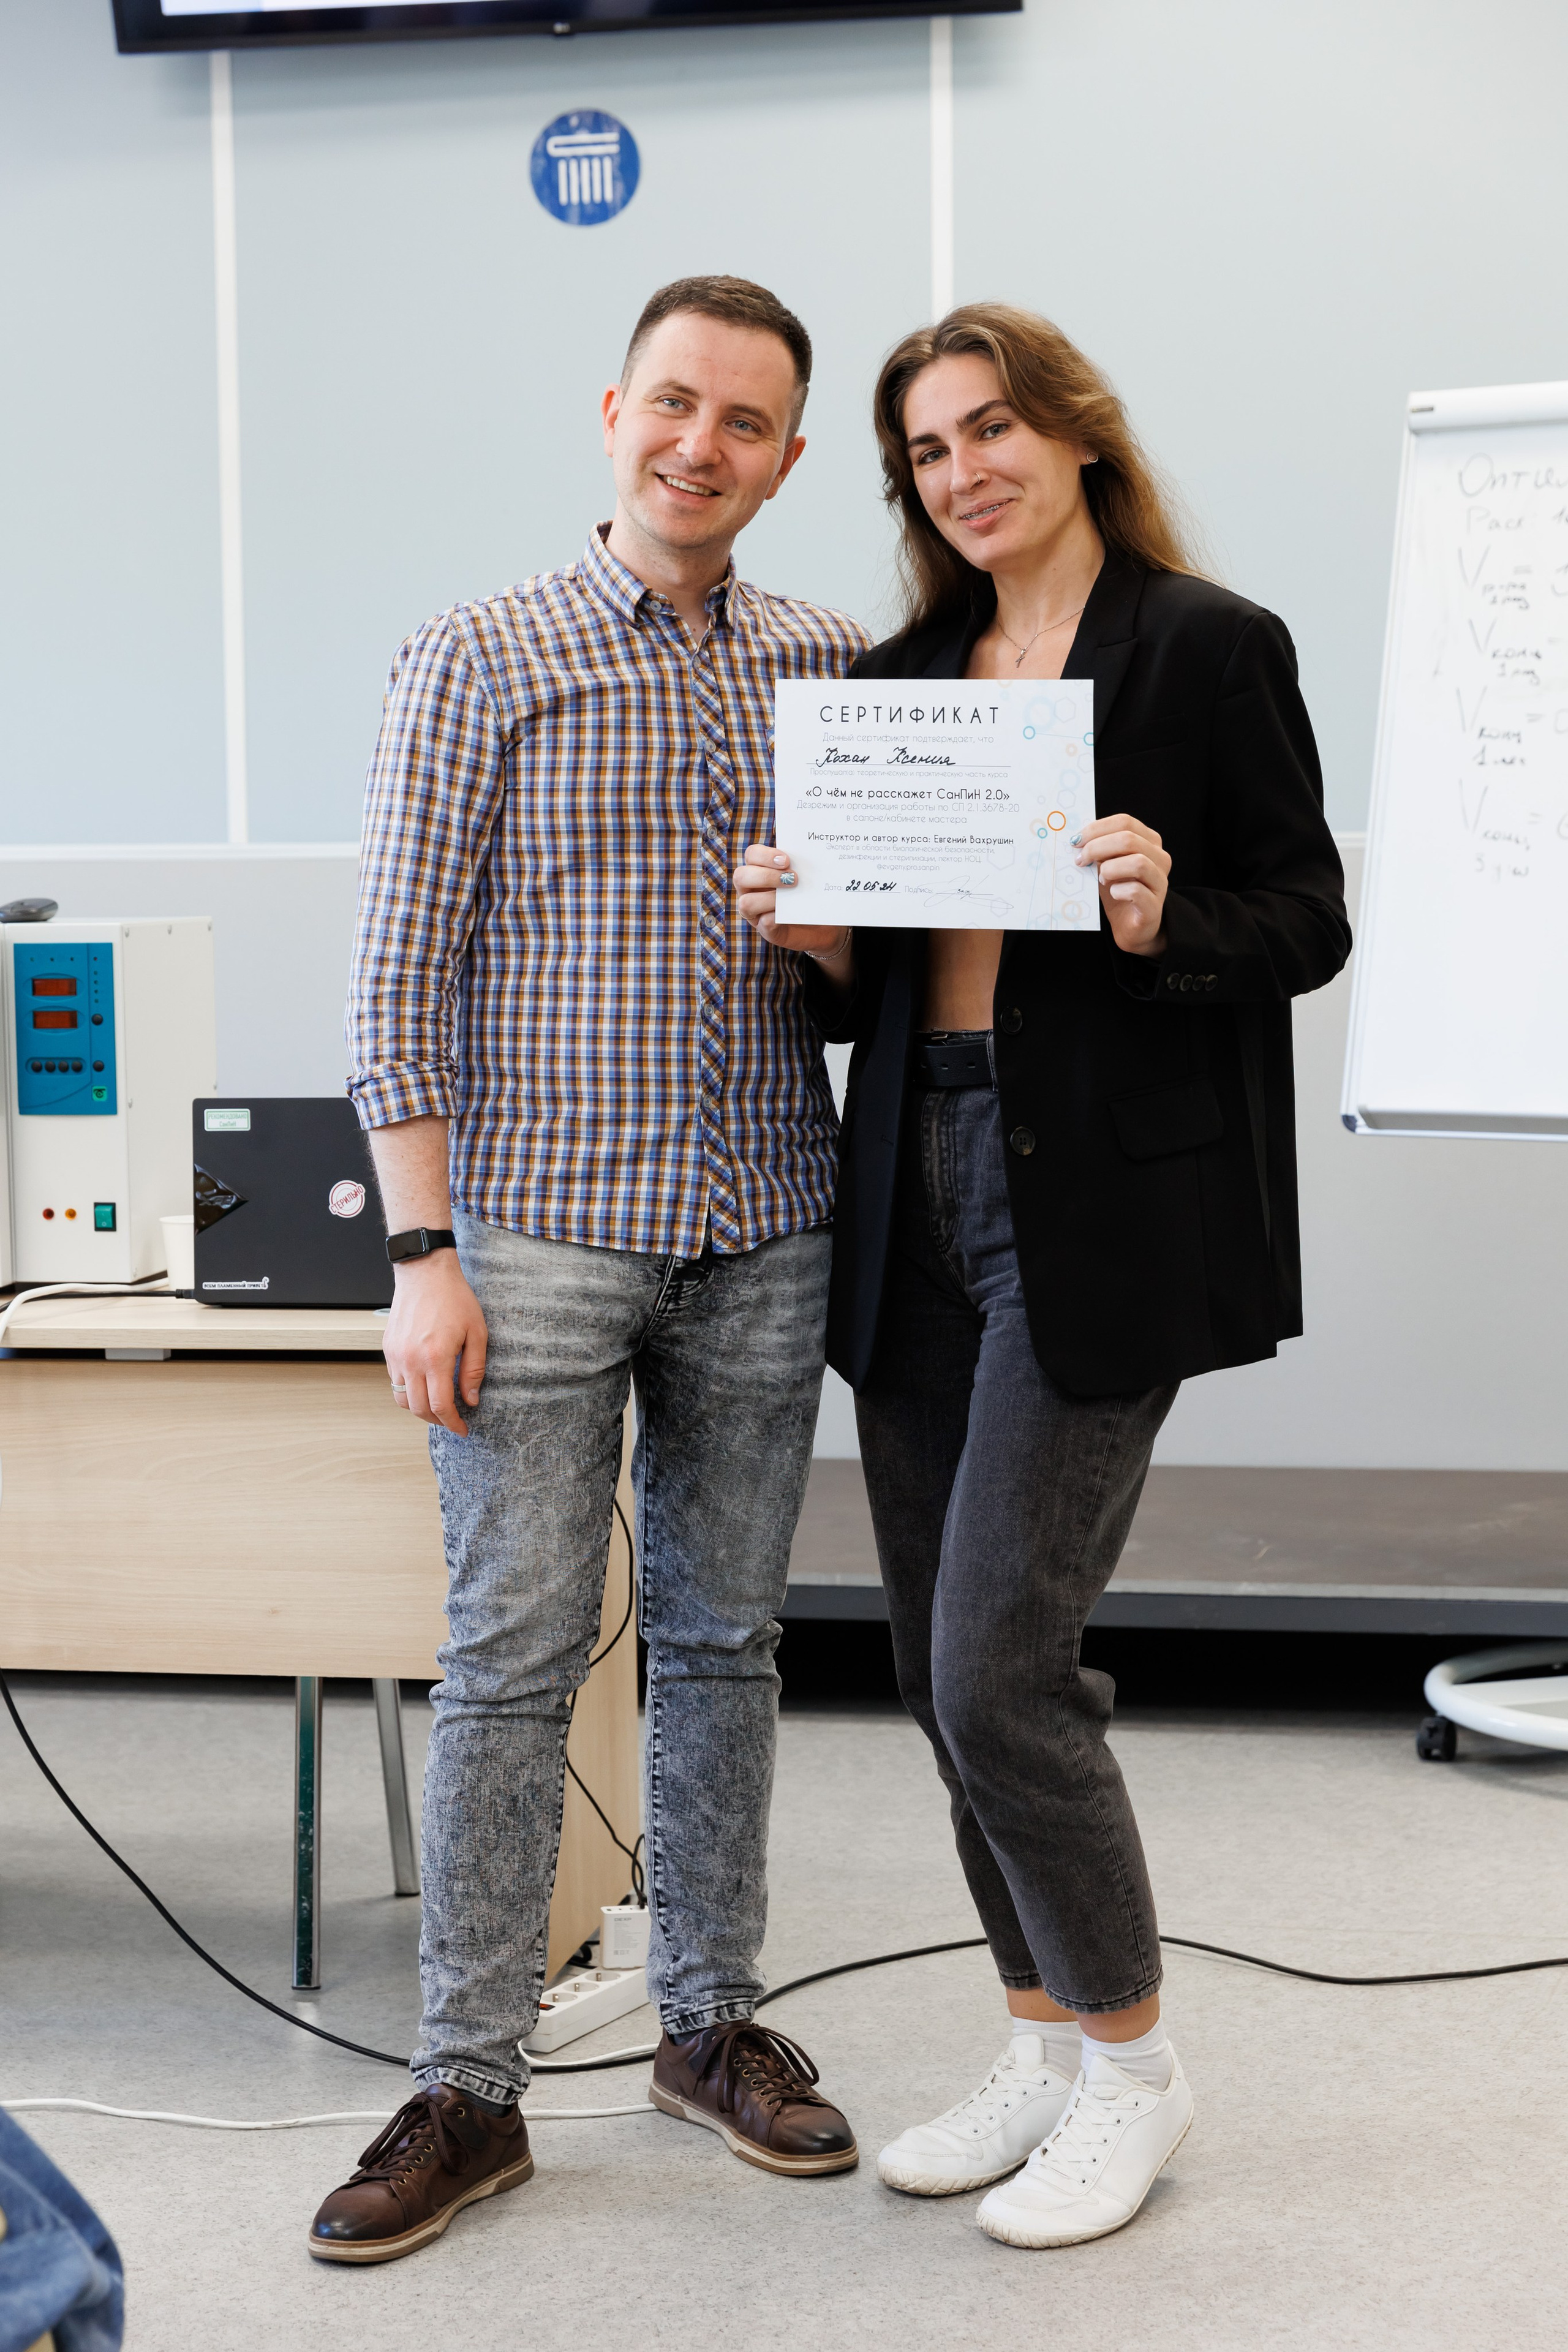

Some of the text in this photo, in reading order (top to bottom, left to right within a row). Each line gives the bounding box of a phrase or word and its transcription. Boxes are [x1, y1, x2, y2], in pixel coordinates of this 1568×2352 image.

[820, 706, 998, 723] СЕРТИФИКАТ
[823, 733, 854, 742] Данный
[857, 734, 910, 743] сертификат
[816, 747, 956, 767] Кохан Ксения
[805, 786, 822, 797] «О
[826, 788, 846, 797] чём
[868, 790, 932, 800] расскажет
[937, 788, 981, 799] СанПиН
[986, 789, 1010, 800] 2.0»
[797, 799, 837, 810] Дезрежим
[846, 802, 898, 811] организация
[901, 802, 935, 812] работы
[952, 802, 965, 812] СП
[967, 803, 1020, 813] 2.1.3678-20
[853, 813, 926, 823] салоне/кабинете
[808, 832, 861, 842] Инструктор
[934, 835, 967, 843] Евгений
[970, 835, 1014, 845] Вахрушин
[905, 885, 933, 894] Подпись:
[331, 1186, 363, 1213] СТЕРИЛЬНО
